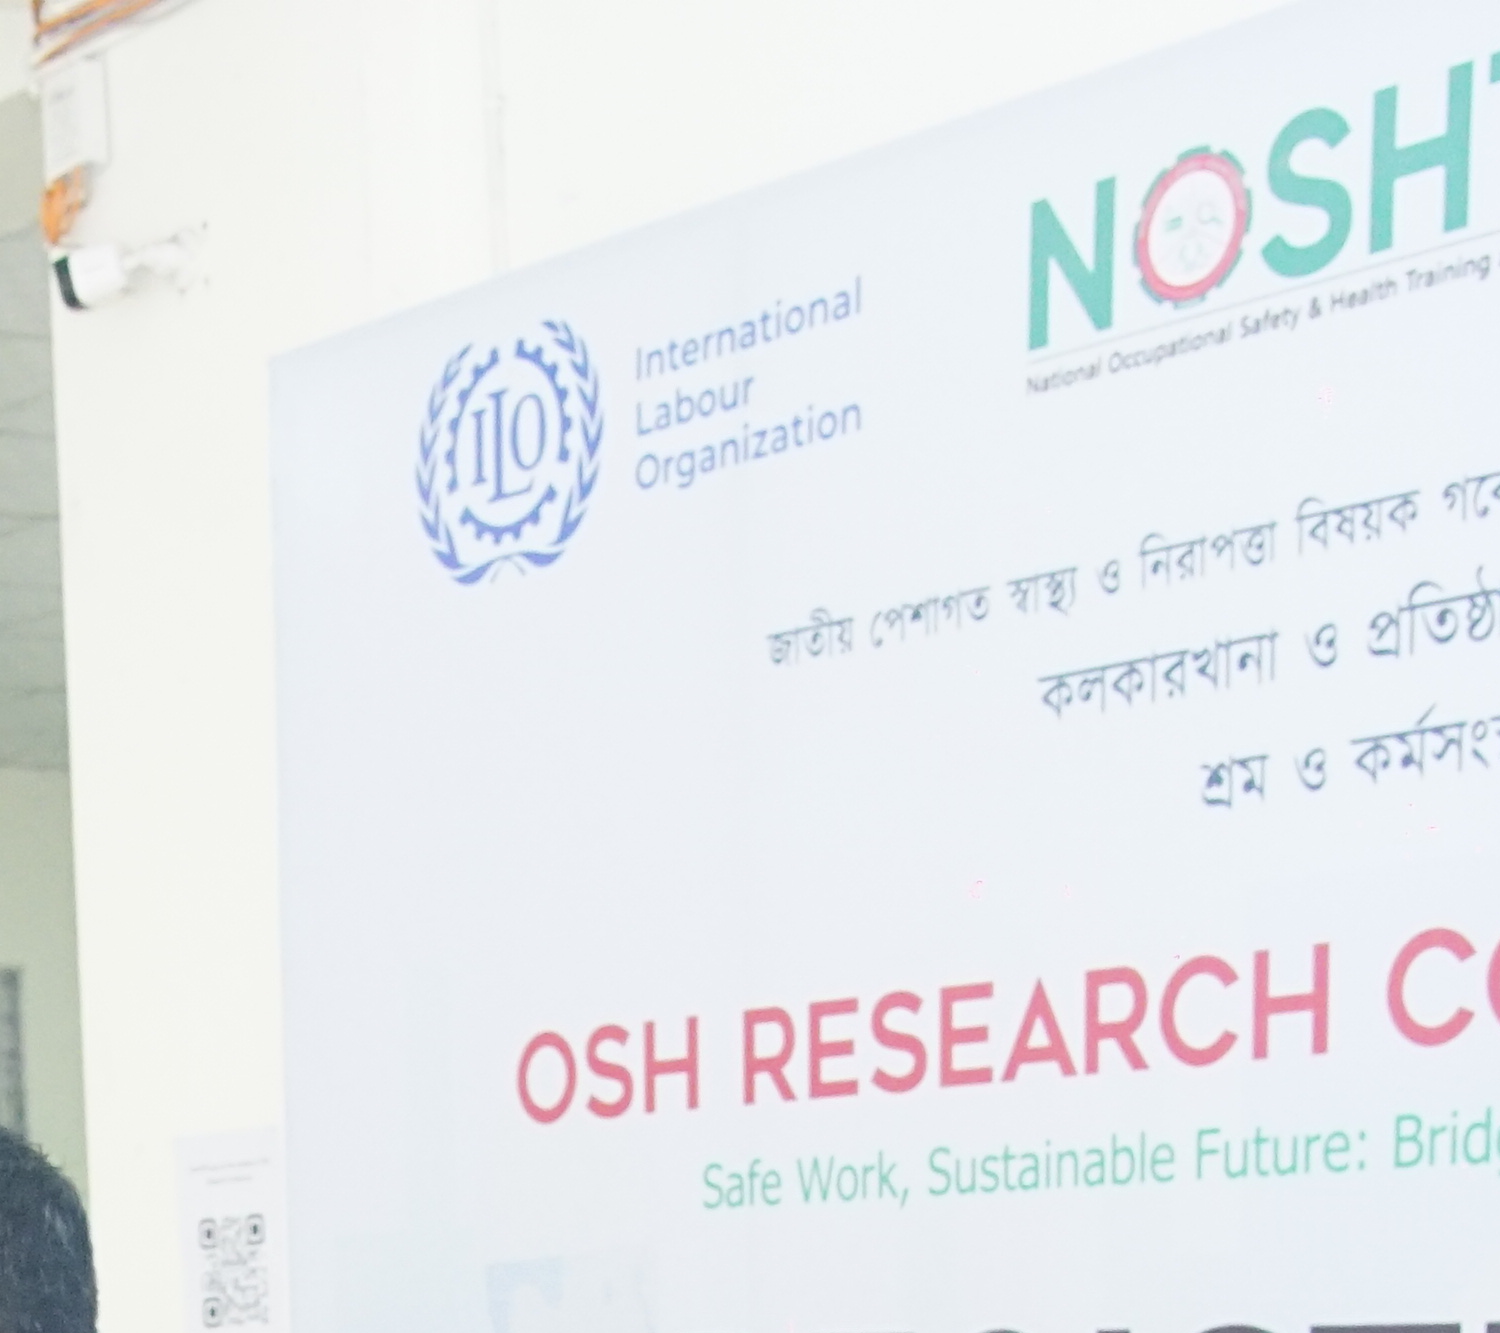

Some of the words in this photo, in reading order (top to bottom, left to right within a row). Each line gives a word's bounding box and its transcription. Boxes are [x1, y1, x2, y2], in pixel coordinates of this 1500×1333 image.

[636, 276, 863, 383] International
[1026, 353, 1101, 397] National
[1108, 319, 1232, 383] Occupational
[1240, 305, 1300, 348] Safety
[1308, 298, 1322, 320] &
[1330, 275, 1397, 316] Health
[1403, 248, 1490, 305] Training
[471, 387, 547, 503] ILO
[636, 373, 754, 437] Labour
[636, 398, 863, 495] Organization
[768, 604, 853, 667] জাতীয়
[868, 578, 990, 651] পেশাগত
[1101, 558, 1120, 592] ও
[1140, 513, 1277, 592] নিরাপত্তা
[1297, 489, 1419, 558] বিষয়ক
[1039, 622, 1278, 717] কলকারখানা
[1306, 615, 1338, 671] ও
[1203, 750, 1267, 808] শ্রম
[1300, 744, 1326, 793] ও
[518, 1016, 700, 1125] OSH
[742, 942, 1331, 1105] RESEARCH
[701, 1161, 783, 1211] Safe
[798, 1150, 911, 1208] Work,
[928, 1135, 1177, 1198] Sustainable
[1194, 1125, 1369, 1181] Future:
